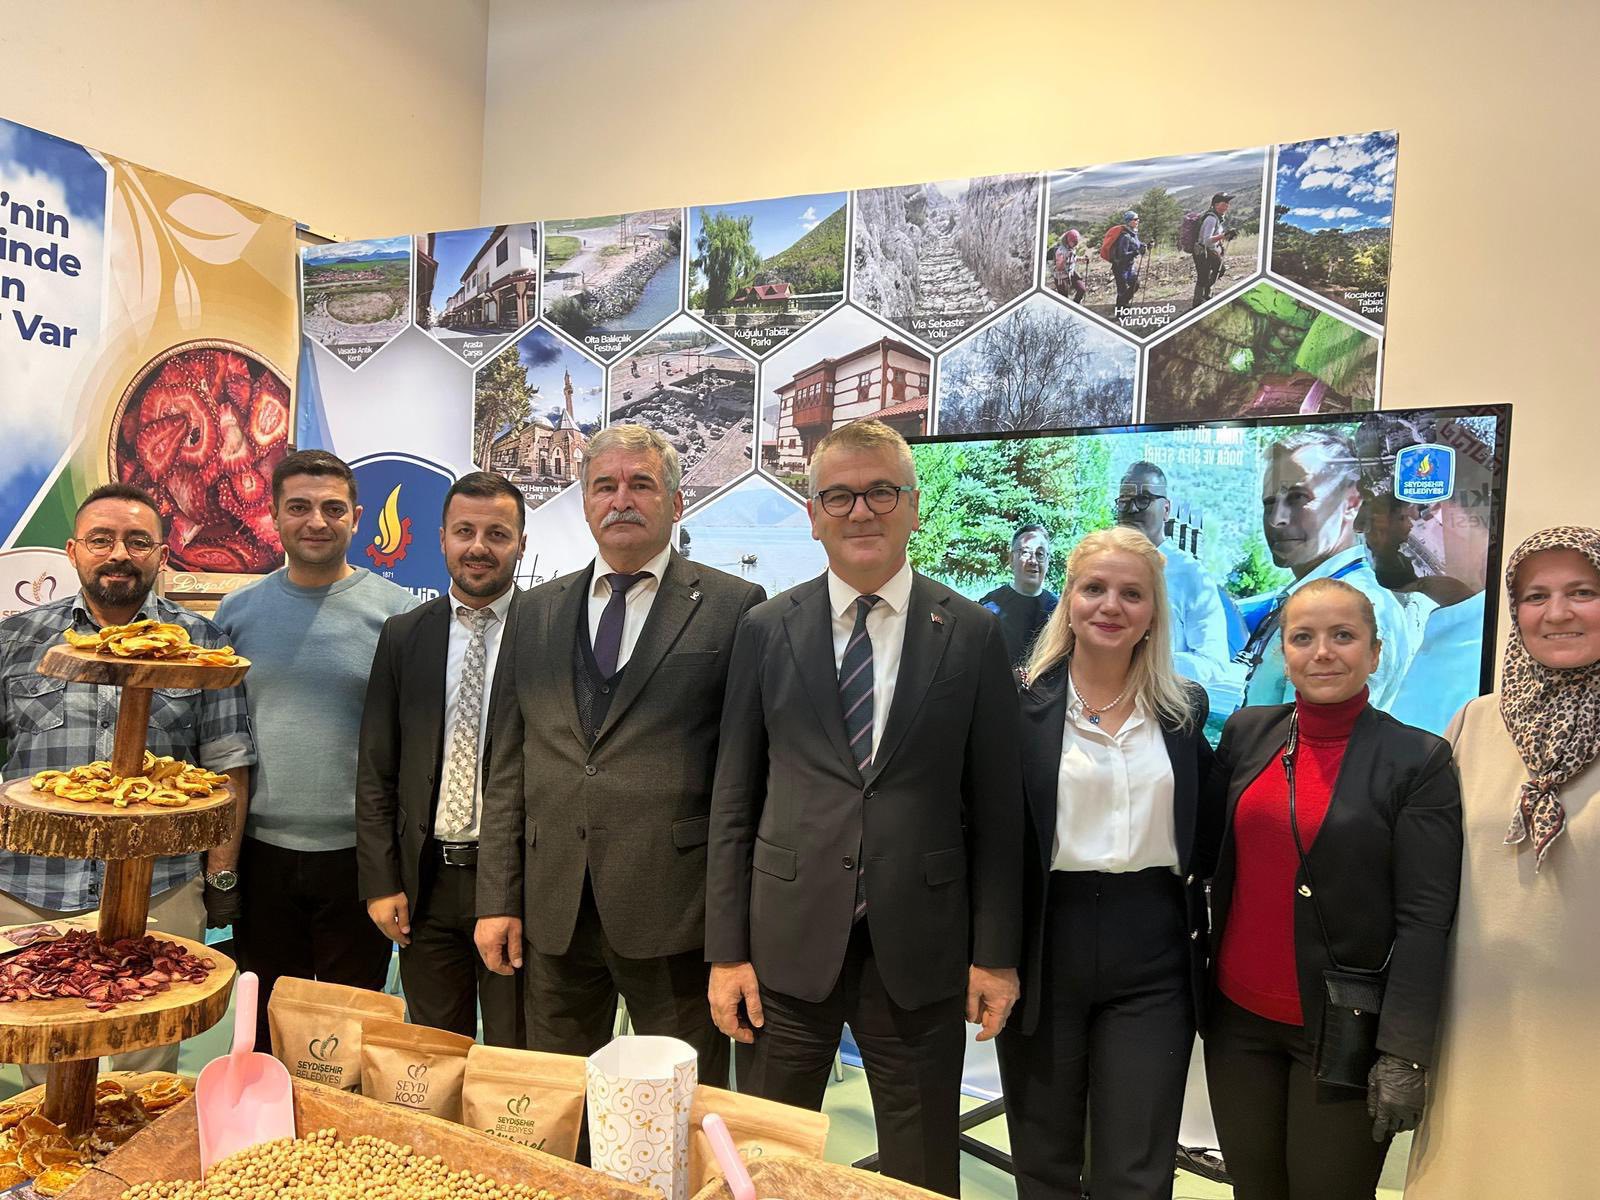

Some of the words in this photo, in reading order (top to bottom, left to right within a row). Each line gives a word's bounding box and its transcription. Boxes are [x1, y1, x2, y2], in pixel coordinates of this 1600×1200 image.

[1344, 290, 1385, 299] Kocakoru
[1358, 298, 1384, 306] Tabiat
[1114, 303, 1176, 316] Homonada
[1361, 305, 1384, 314] Parkı
[911, 320, 926, 329] Via
[927, 318, 965, 328] Sebaste
[1118, 313, 1171, 328] Yürüyüşü
[12, 309, 78, 348] Var
[734, 328, 763, 340] Kuğulu
[764, 326, 791, 337] Tabiat
[927, 328, 948, 338] Yolu
[584, 335, 600, 344] Olta
[750, 337, 772, 346] Parkı
[462, 341, 484, 349] Arasta
[593, 343, 622, 352] Festivali
[529, 485, 549, 493] Harun
[382, 571, 394, 579] 1871
[394, 1091, 425, 1105] KOOP
